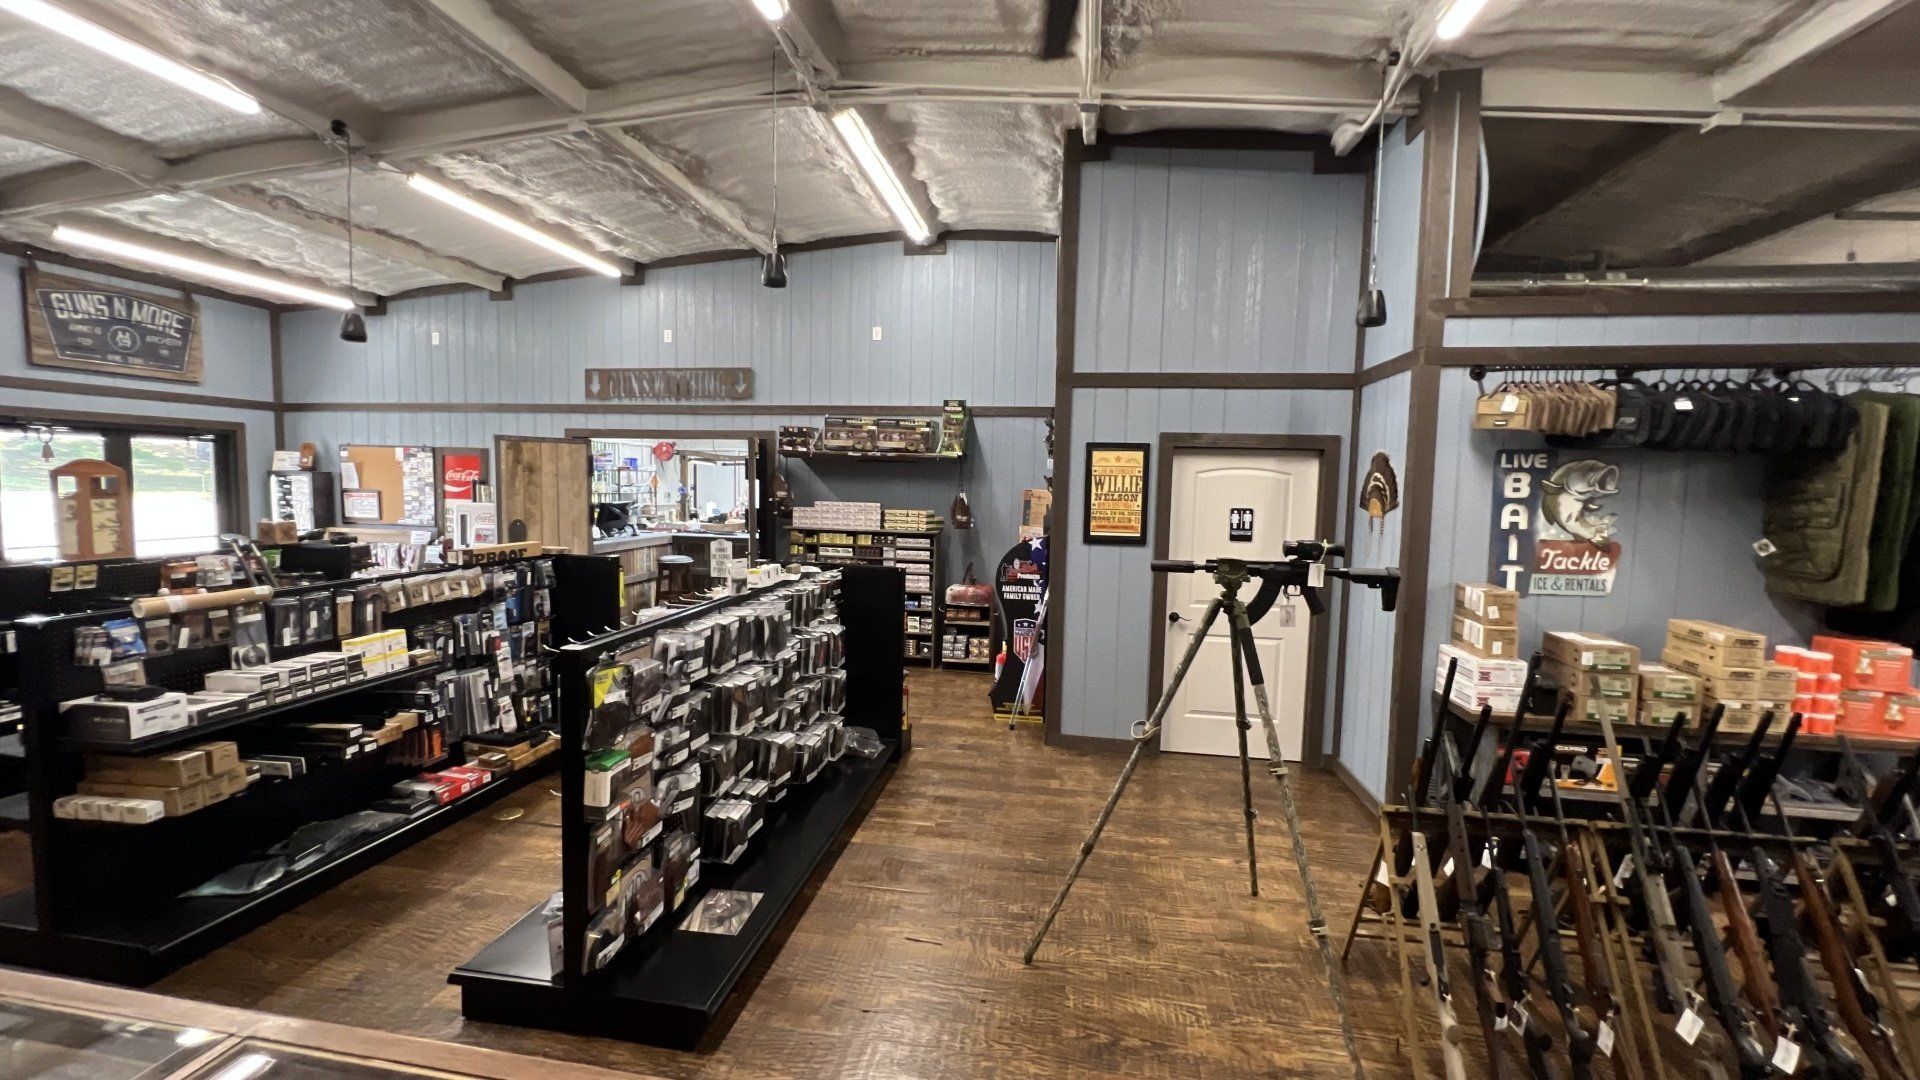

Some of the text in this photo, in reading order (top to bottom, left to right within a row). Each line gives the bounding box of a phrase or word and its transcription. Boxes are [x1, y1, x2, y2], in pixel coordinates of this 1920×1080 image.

[50, 293, 185, 338] GUNS N MORE
[1500, 453, 1548, 468] LIVE
[1093, 475, 1142, 493] WILLIE
[1094, 493, 1139, 502] NELSON
[1500, 471, 1531, 592] BAIT
[1540, 548, 1610, 570] Tackle
[1002, 585, 1042, 594] AMERICAN MADE
[1533, 577, 1607, 592] ICE & RENTALS
[1003, 592, 1041, 601] FAMILY OWNED
